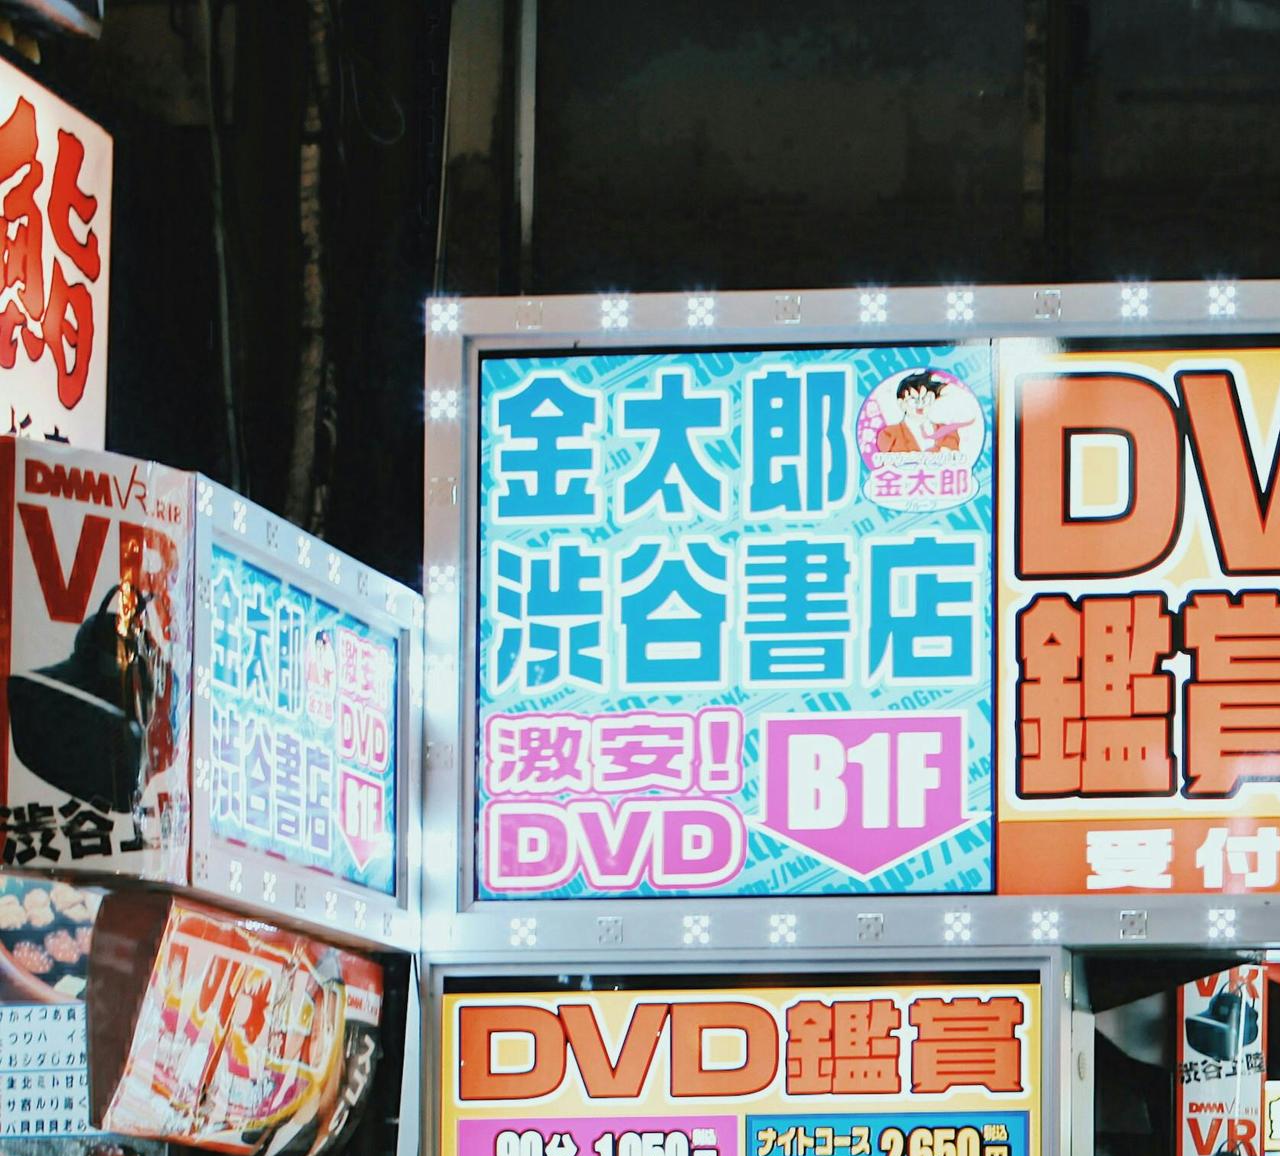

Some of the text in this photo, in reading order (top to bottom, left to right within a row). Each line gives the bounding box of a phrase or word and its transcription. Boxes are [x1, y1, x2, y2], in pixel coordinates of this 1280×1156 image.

[25, 458, 112, 507] DMM
[495, 367, 852, 519] 金太郎
[875, 468, 969, 497] 金太郎
[17, 501, 180, 645] VR
[496, 537, 982, 688] 渋谷書店
[211, 570, 304, 722] 金太郎
[340, 700, 389, 774] DVD
[495, 720, 740, 785] 激安!
[211, 703, 333, 858] 渋谷書店
[787, 732, 942, 830] B1F
[497, 806, 740, 881] DVD
[459, 997, 1025, 1100] DVD鑑賞
[757, 1126, 872, 1156] ナイトコース
[1187, 1118, 1257, 1156] VR
